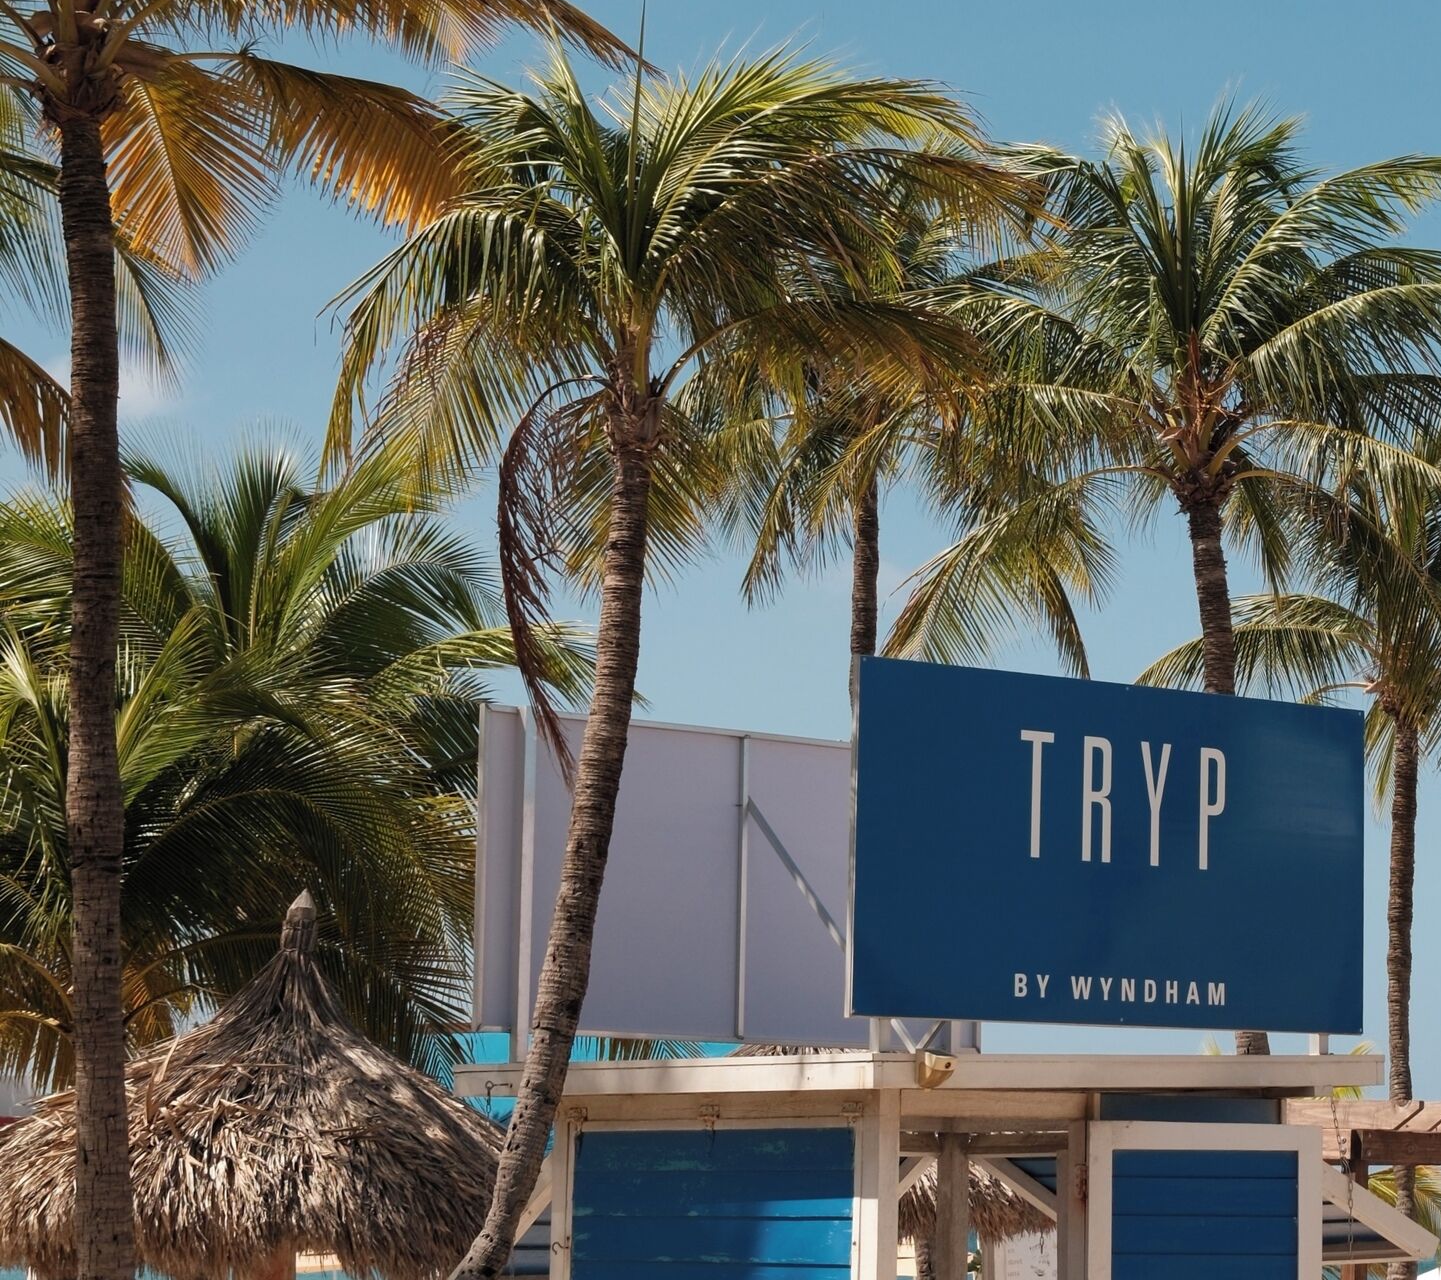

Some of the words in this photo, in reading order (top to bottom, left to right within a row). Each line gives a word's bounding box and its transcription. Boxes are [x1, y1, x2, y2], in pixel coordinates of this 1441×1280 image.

[1020, 729, 1226, 871] TRYP
[1014, 973, 1050, 998] BY
[1070, 975, 1226, 1007] WYNDHAM
